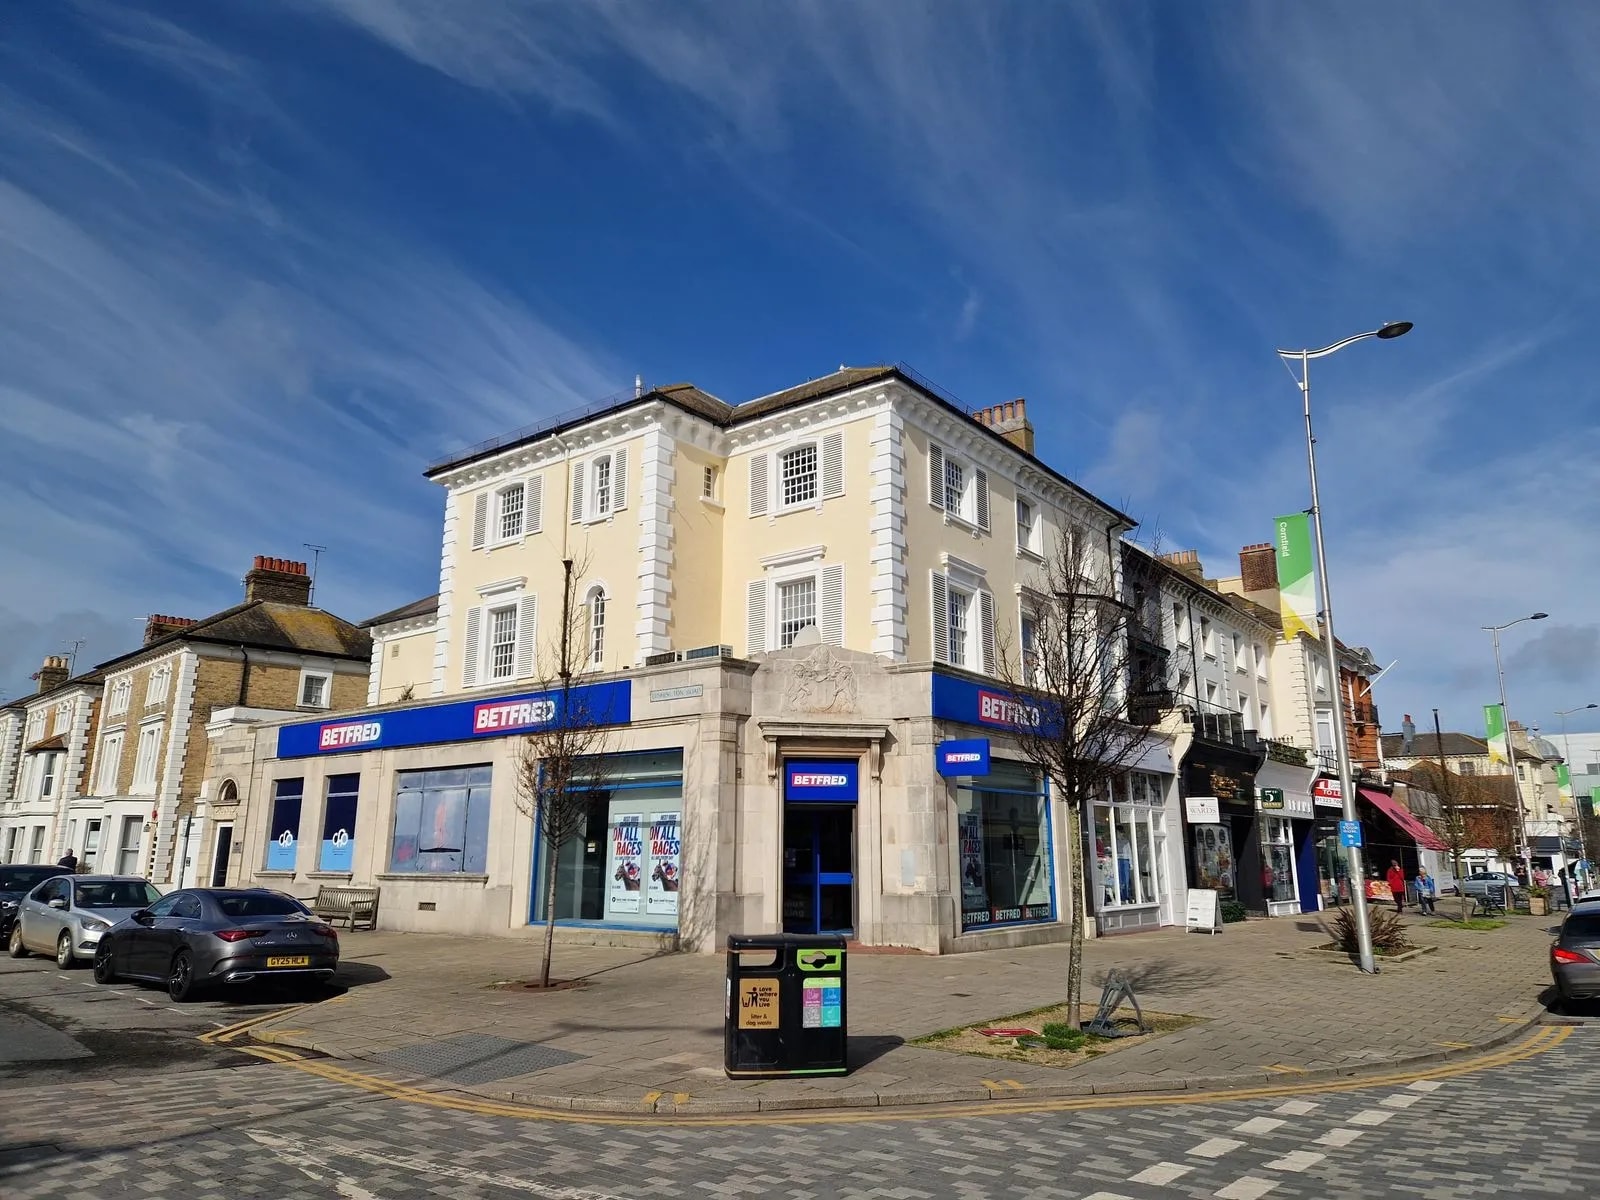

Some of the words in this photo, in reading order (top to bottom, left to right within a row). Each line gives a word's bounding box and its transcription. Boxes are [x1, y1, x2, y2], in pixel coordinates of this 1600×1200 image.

[475, 700, 555, 729] BETFRED
[321, 722, 381, 747] BETFRED
[946, 753, 981, 763] BETFRED
[793, 775, 847, 785] BETFRED
[613, 827, 624, 841] ON
[624, 827, 639, 841] ALL
[650, 825, 661, 841] ON
[661, 825, 676, 840] ALL
[616, 841, 643, 856] RACES
[652, 840, 680, 856] RACES
[962, 911, 990, 924] BETFRED
[995, 908, 1021, 921] BETFRED
[1026, 906, 1049, 918] BETFRED
